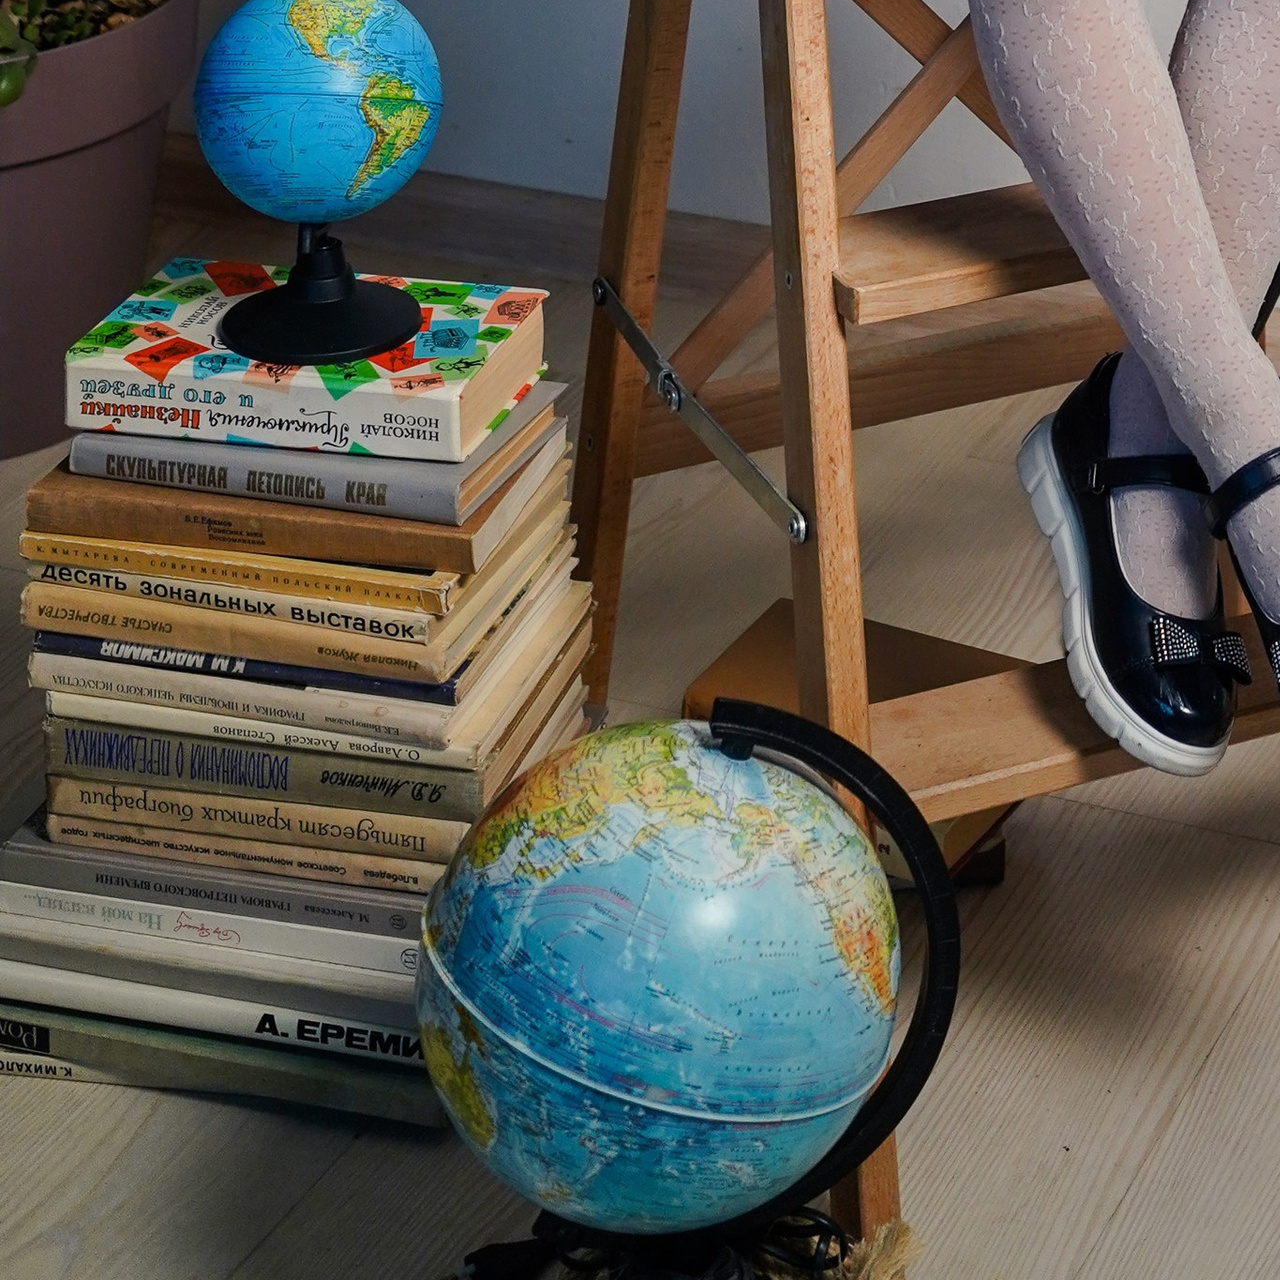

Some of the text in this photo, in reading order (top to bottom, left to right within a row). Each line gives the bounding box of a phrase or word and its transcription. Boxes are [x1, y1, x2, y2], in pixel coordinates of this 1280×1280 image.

[178, 295, 220, 329] НИКОЛАЙ
[196, 301, 228, 325] НОСОВ
[80, 378, 254, 407] и его друзей
[80, 400, 350, 448] Приключения Незнайки
[383, 412, 440, 428] НОСОВ
[360, 422, 440, 442] НИКОЛАЙ
[105, 454, 388, 507] СКУЛЬПТУРНАЯ ЛЕТОПИСЬ КРАЯ
[36, 545, 422, 603] К. МЫТАРЕВА СОВРЕМЕННЫЙ ПОЛЬСКИЙ ПЛАКАТ
[38, 605, 173, 634] СЧАСТЬЕ ТВОРЧЕСТВА
[100, 639, 205, 669] МАКСИМОВ
[317, 646, 419, 672] Николай Жуков
[52, 674, 114, 689] ИСКУССТВА
[116, 683, 175, 701] ЧЕШСКОГО
[178, 692, 239, 710] ПРОБЛЕМЫ
[242, 702, 250, 711] И
[254, 704, 305, 722] ГРАФИКА
[213, 725, 275, 744] Степанов
[284, 734, 339, 751] Алексей
[64, 728, 170, 776] ПЕРЕДВИЖНИКАХ
[176, 741, 184, 778] О
[190, 743, 289, 791] ВОСПОМИНАНИЯ
[79, 786, 427, 853] Пятьдесят кратких биографий
[61, 827, 88, 838] годов
[93, 831, 160, 848] шестидесятых
[163, 841, 210, 855] искусство
[213, 848, 294, 867] монументальное
[297, 860, 347, 875] Советское
[95, 873, 151, 891] ВРЕМЕНИ
[153, 881, 238, 904] ПЕТРОВСКОГО
[240, 895, 291, 912] ГРАВЮРА
[304, 904, 357, 921] Алексеева
[101, 906, 134, 923] мой
[138, 912, 163, 931] На
[254, 1013, 289, 1039] А.
[60, 1066, 73, 1077] К.
